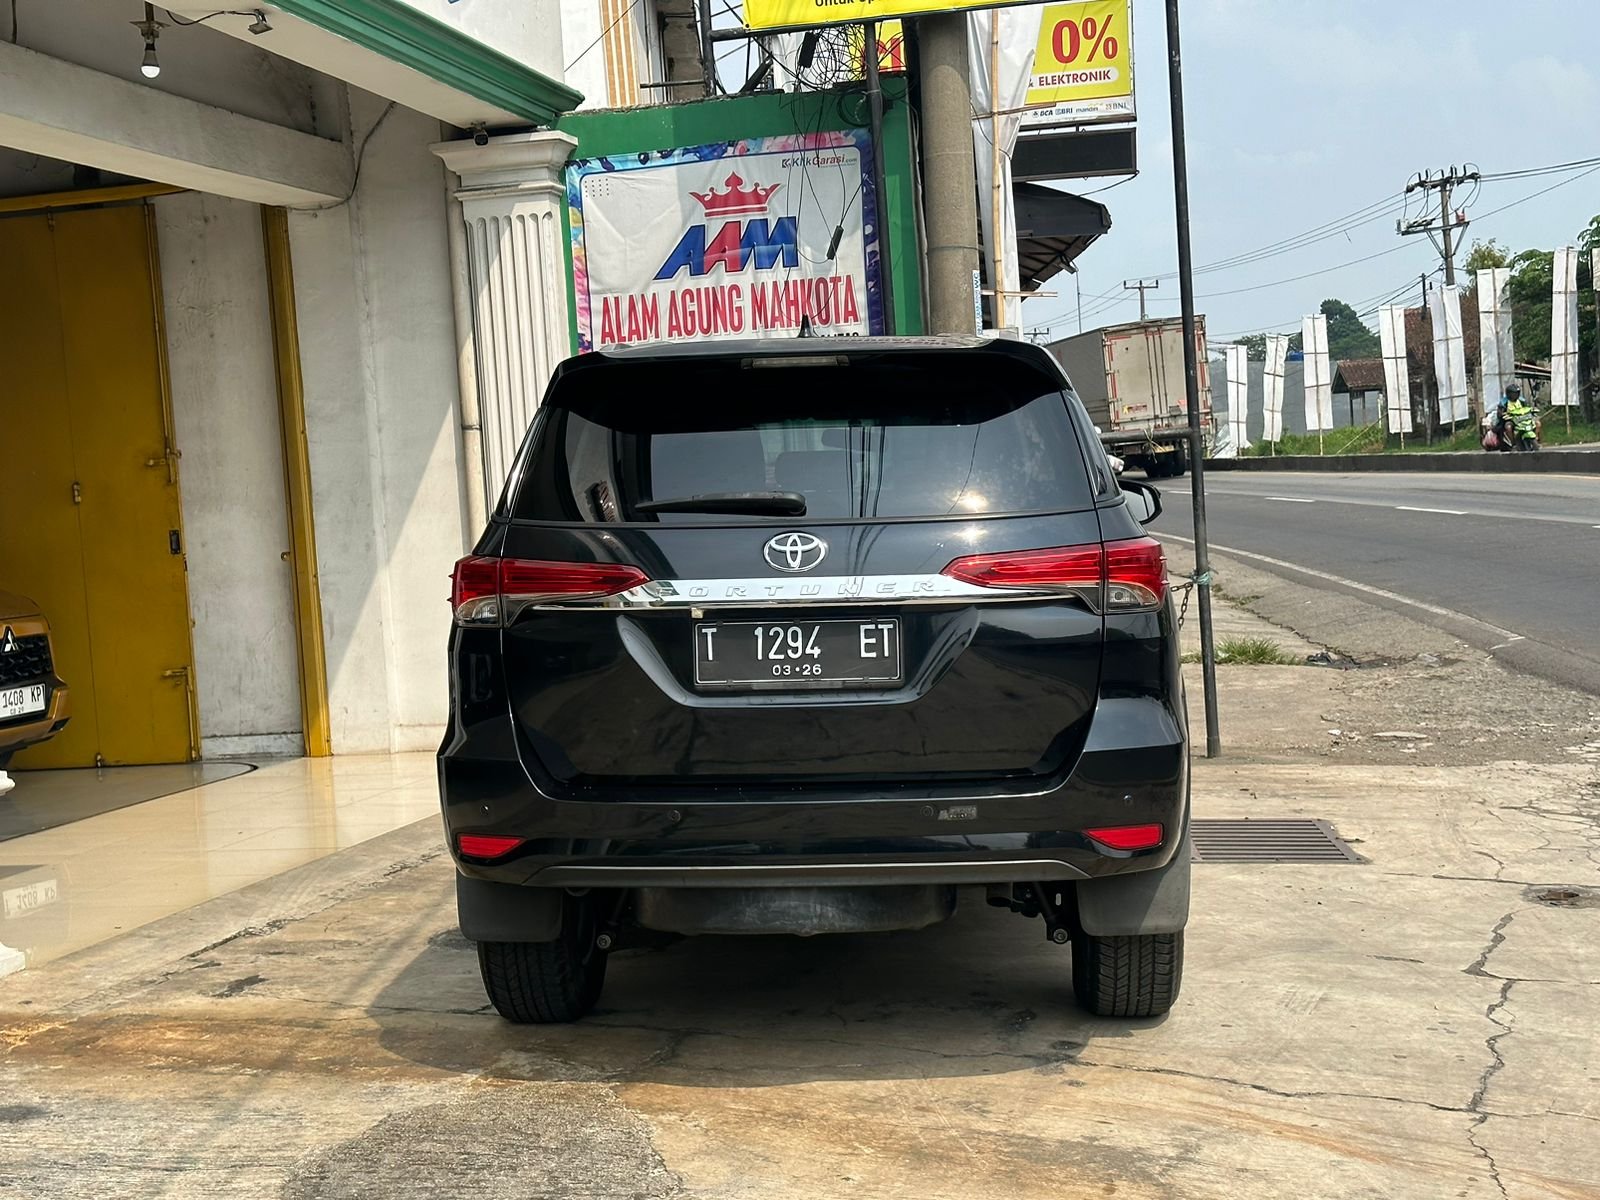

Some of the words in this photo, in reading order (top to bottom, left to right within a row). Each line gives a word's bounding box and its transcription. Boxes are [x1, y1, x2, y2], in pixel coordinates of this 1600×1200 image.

[1052, 14, 1118, 63] 0%
[1038, 69, 1111, 87] ELEKTRONIK
[653, 216, 799, 281] AAM
[601, 292, 660, 345] ALAM
[668, 283, 743, 338] AGUNG
[751, 275, 860, 331] MAHKOTA
[656, 581, 938, 597] FORTUNER
[702, 627, 717, 661] T
[754, 625, 822, 661] 1294
[860, 623, 893, 658] ET
[2, 689, 24, 709] 1408
[31, 686, 41, 702] KP
